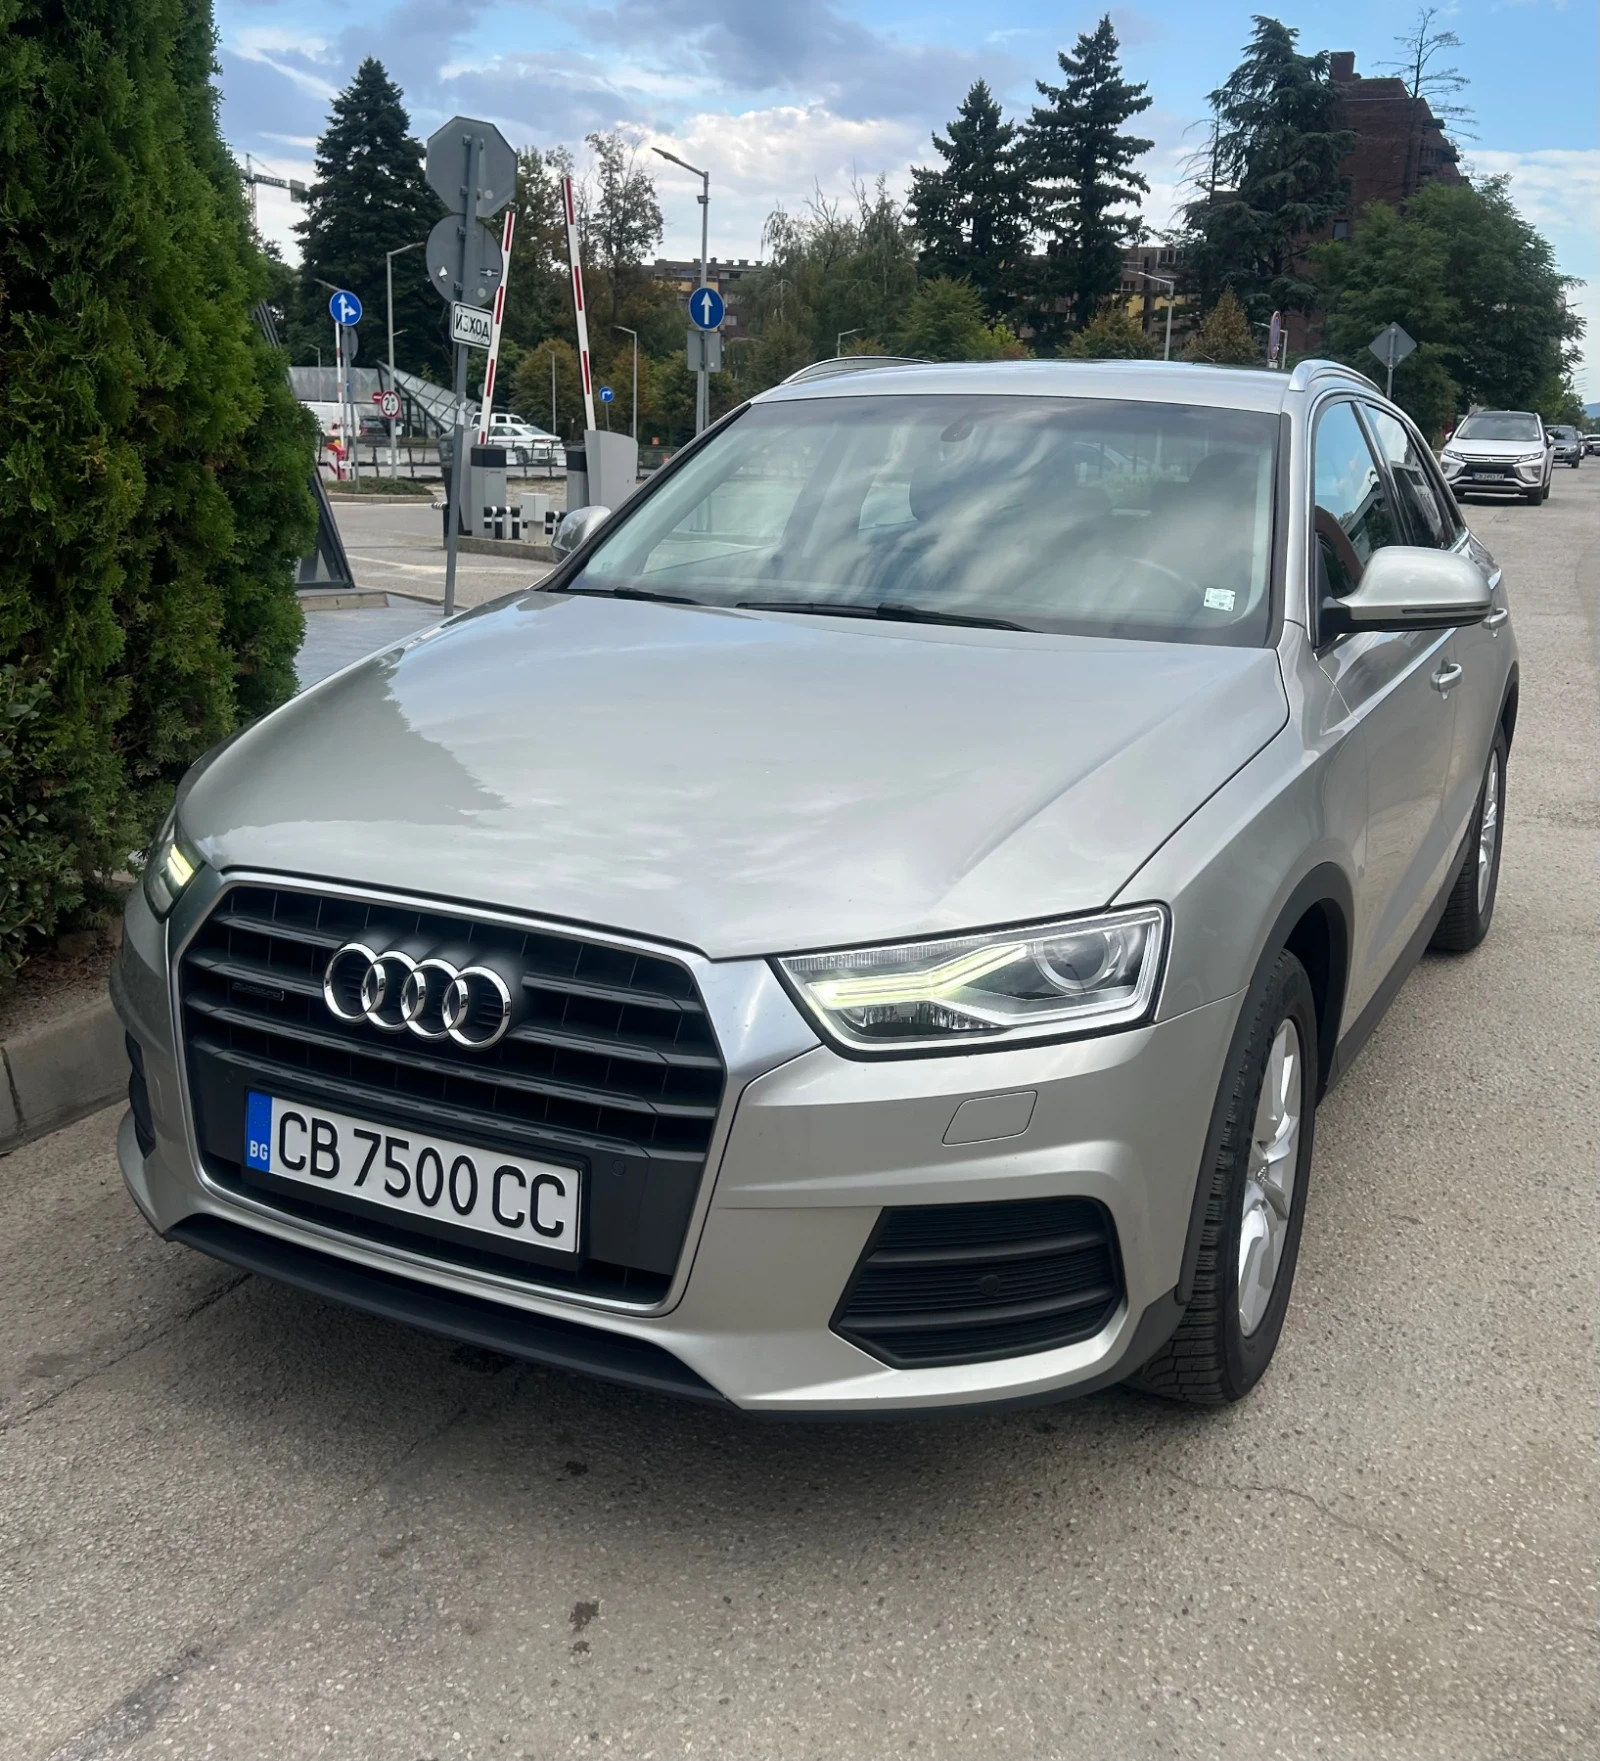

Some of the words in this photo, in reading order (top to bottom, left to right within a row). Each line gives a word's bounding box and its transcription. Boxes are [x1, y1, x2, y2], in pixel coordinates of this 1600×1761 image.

[455, 312, 490, 340] ИЗХОД
[250, 1141, 268, 1160] BG
[279, 1111, 340, 1179] CB
[353, 1128, 478, 1216] 7500
[492, 1164, 566, 1238] CC
